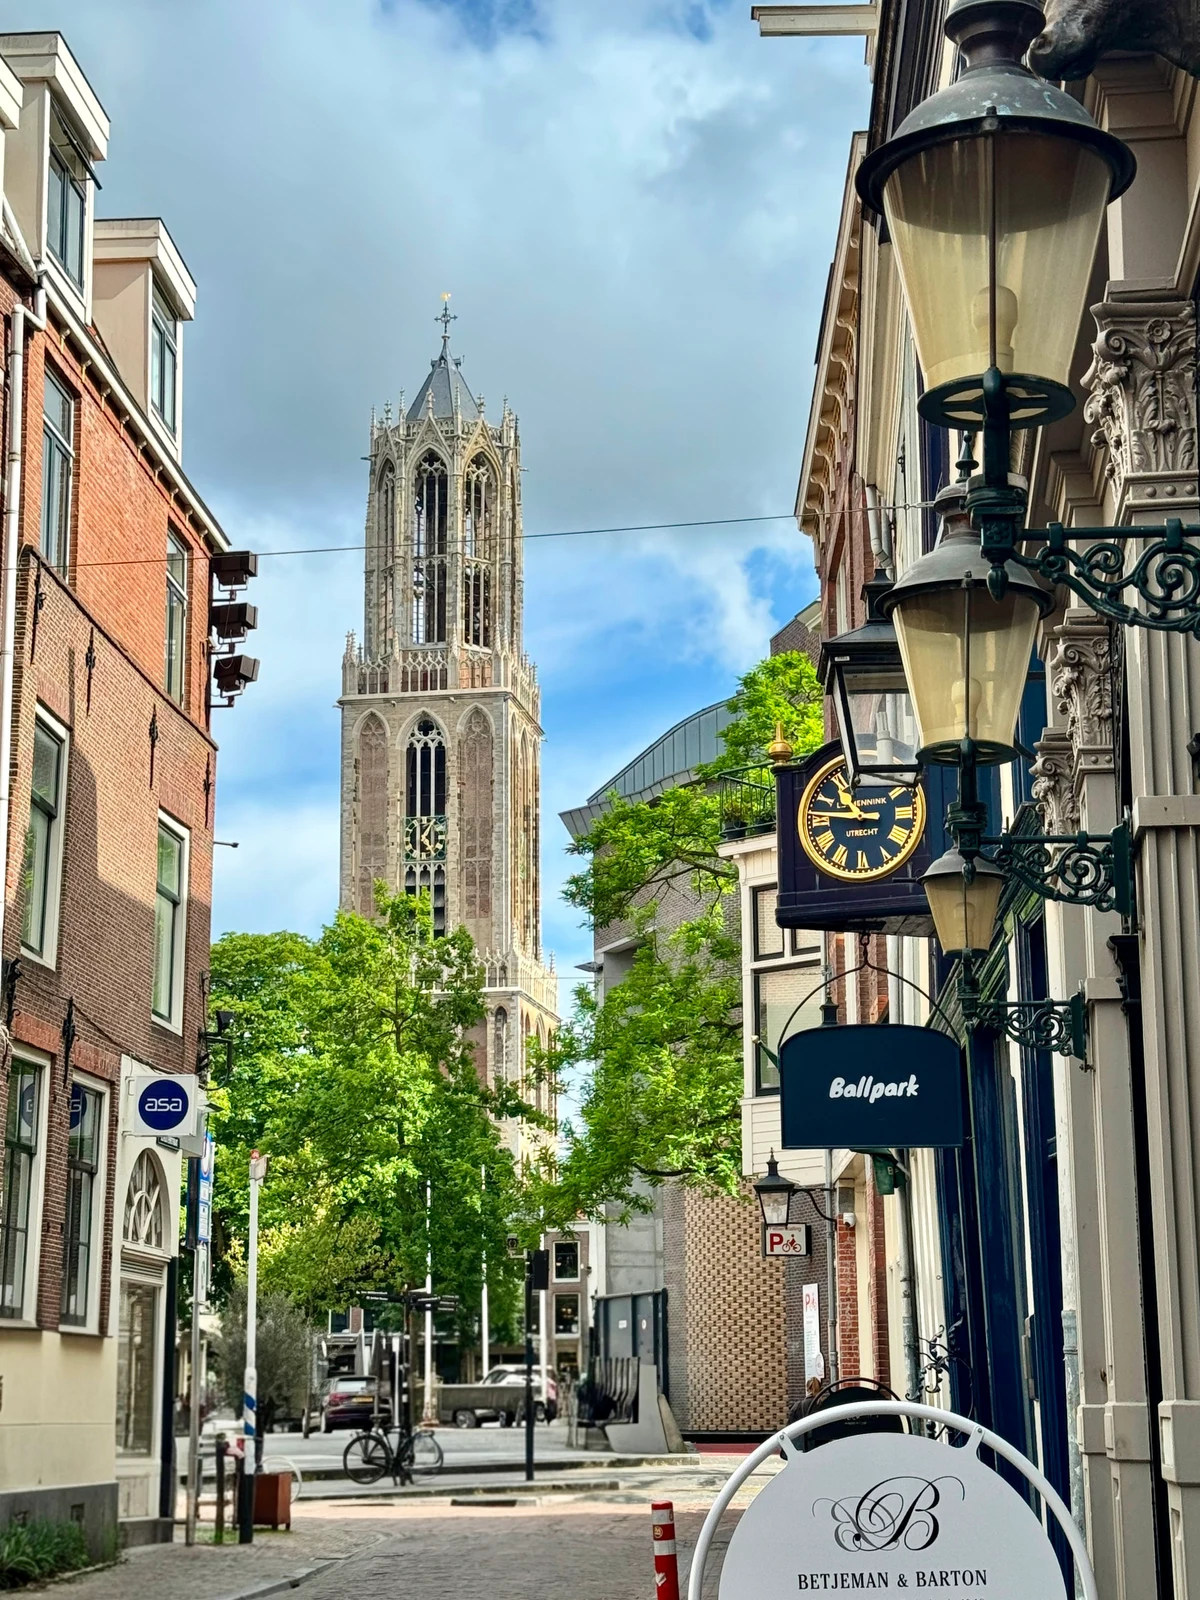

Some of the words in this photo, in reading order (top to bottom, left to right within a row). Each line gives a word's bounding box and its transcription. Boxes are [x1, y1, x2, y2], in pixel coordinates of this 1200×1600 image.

[846, 828, 879, 837] UTRECHT
[829, 1074, 920, 1104] Ballpark
[145, 1098, 182, 1112] asa
[769, 1232, 784, 1253] P
[797, 1571, 890, 1590] BETJEMAN
[896, 1573, 909, 1588] &
[915, 1569, 988, 1588] BARTON
